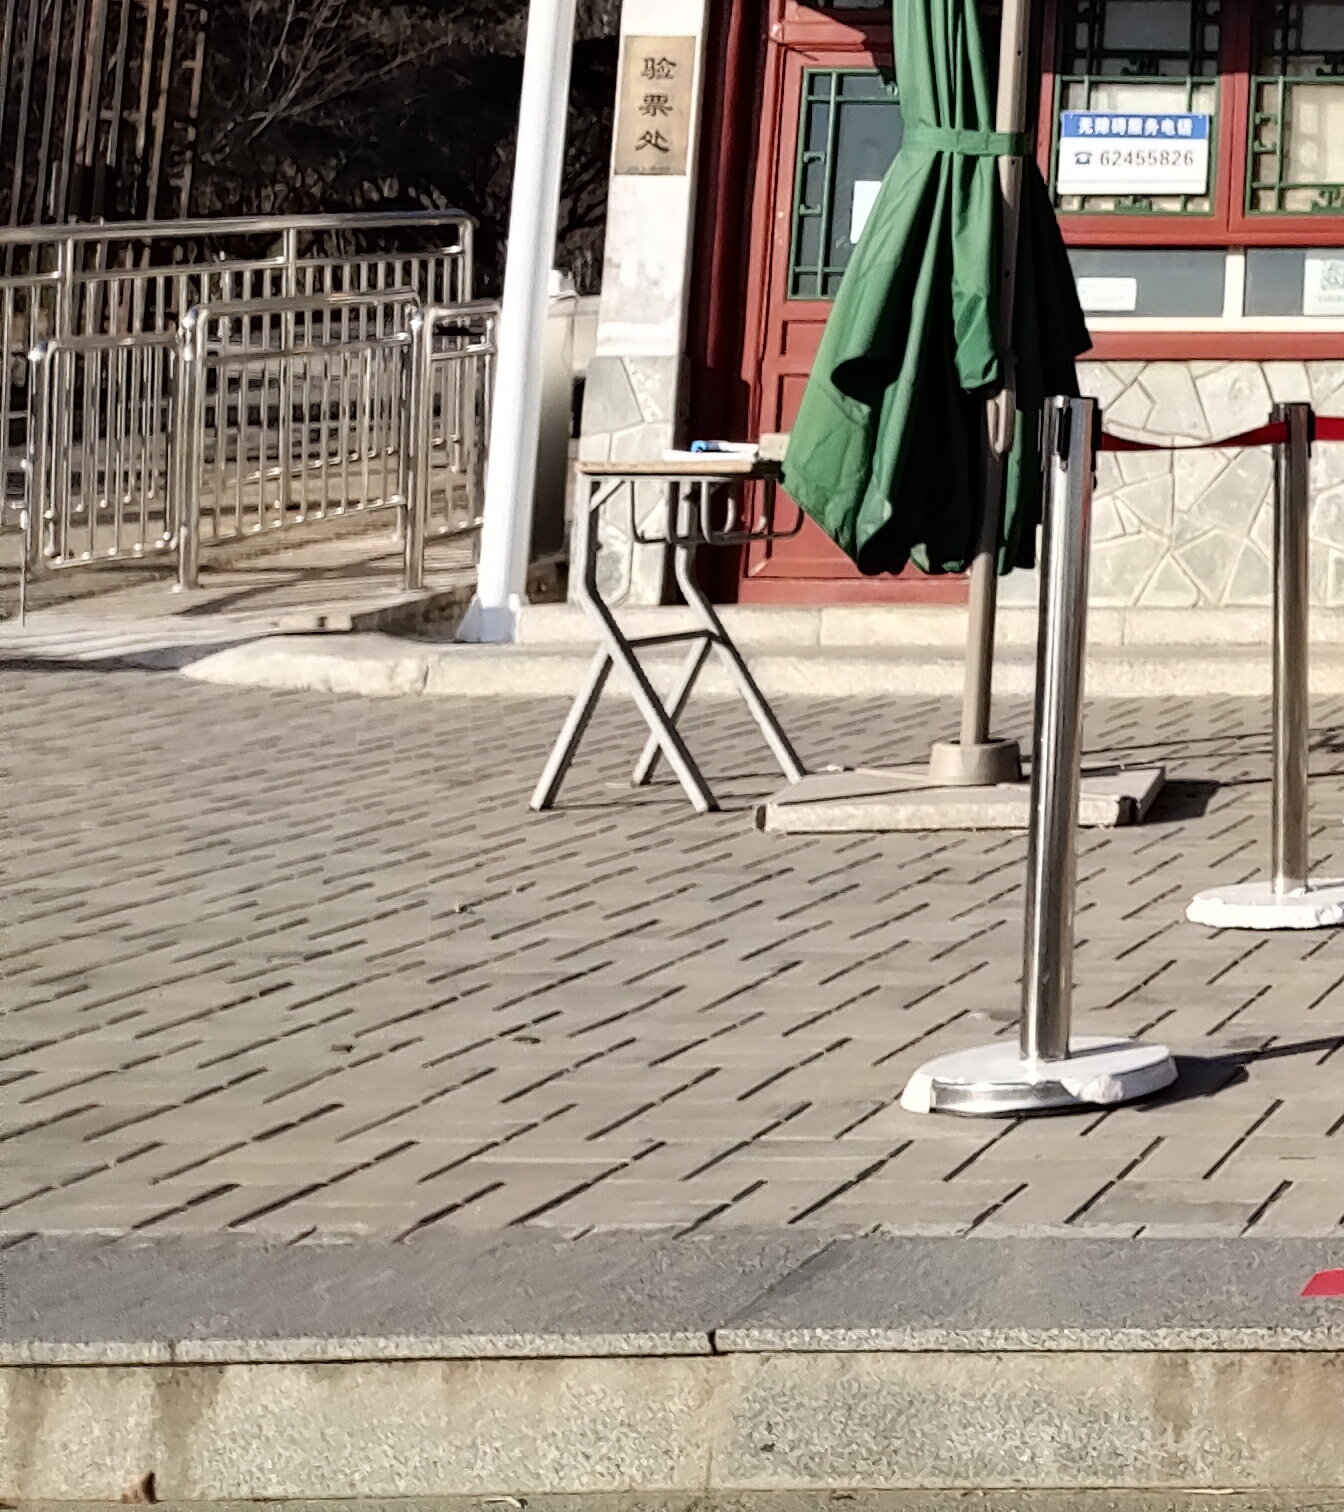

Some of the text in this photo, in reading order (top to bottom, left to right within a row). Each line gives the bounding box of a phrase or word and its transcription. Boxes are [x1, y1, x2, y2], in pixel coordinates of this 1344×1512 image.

[634, 56, 677, 154] 验票处
[1099, 148, 1194, 167] 62455826
